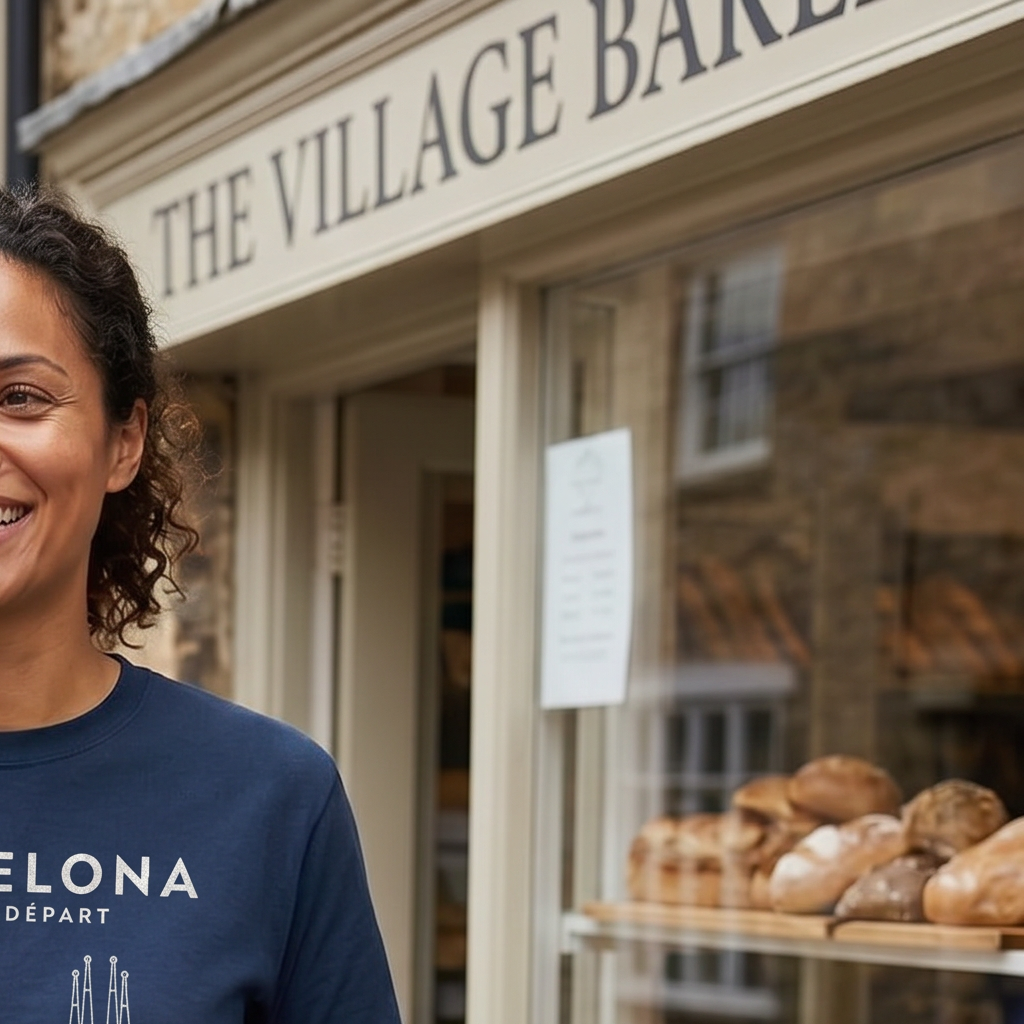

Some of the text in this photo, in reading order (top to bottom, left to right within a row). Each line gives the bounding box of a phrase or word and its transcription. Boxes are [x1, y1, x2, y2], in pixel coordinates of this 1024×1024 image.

[153, 167, 254, 297] THE
[267, 15, 563, 247] VILLAGE
[5, 902, 111, 925] DÉPART
